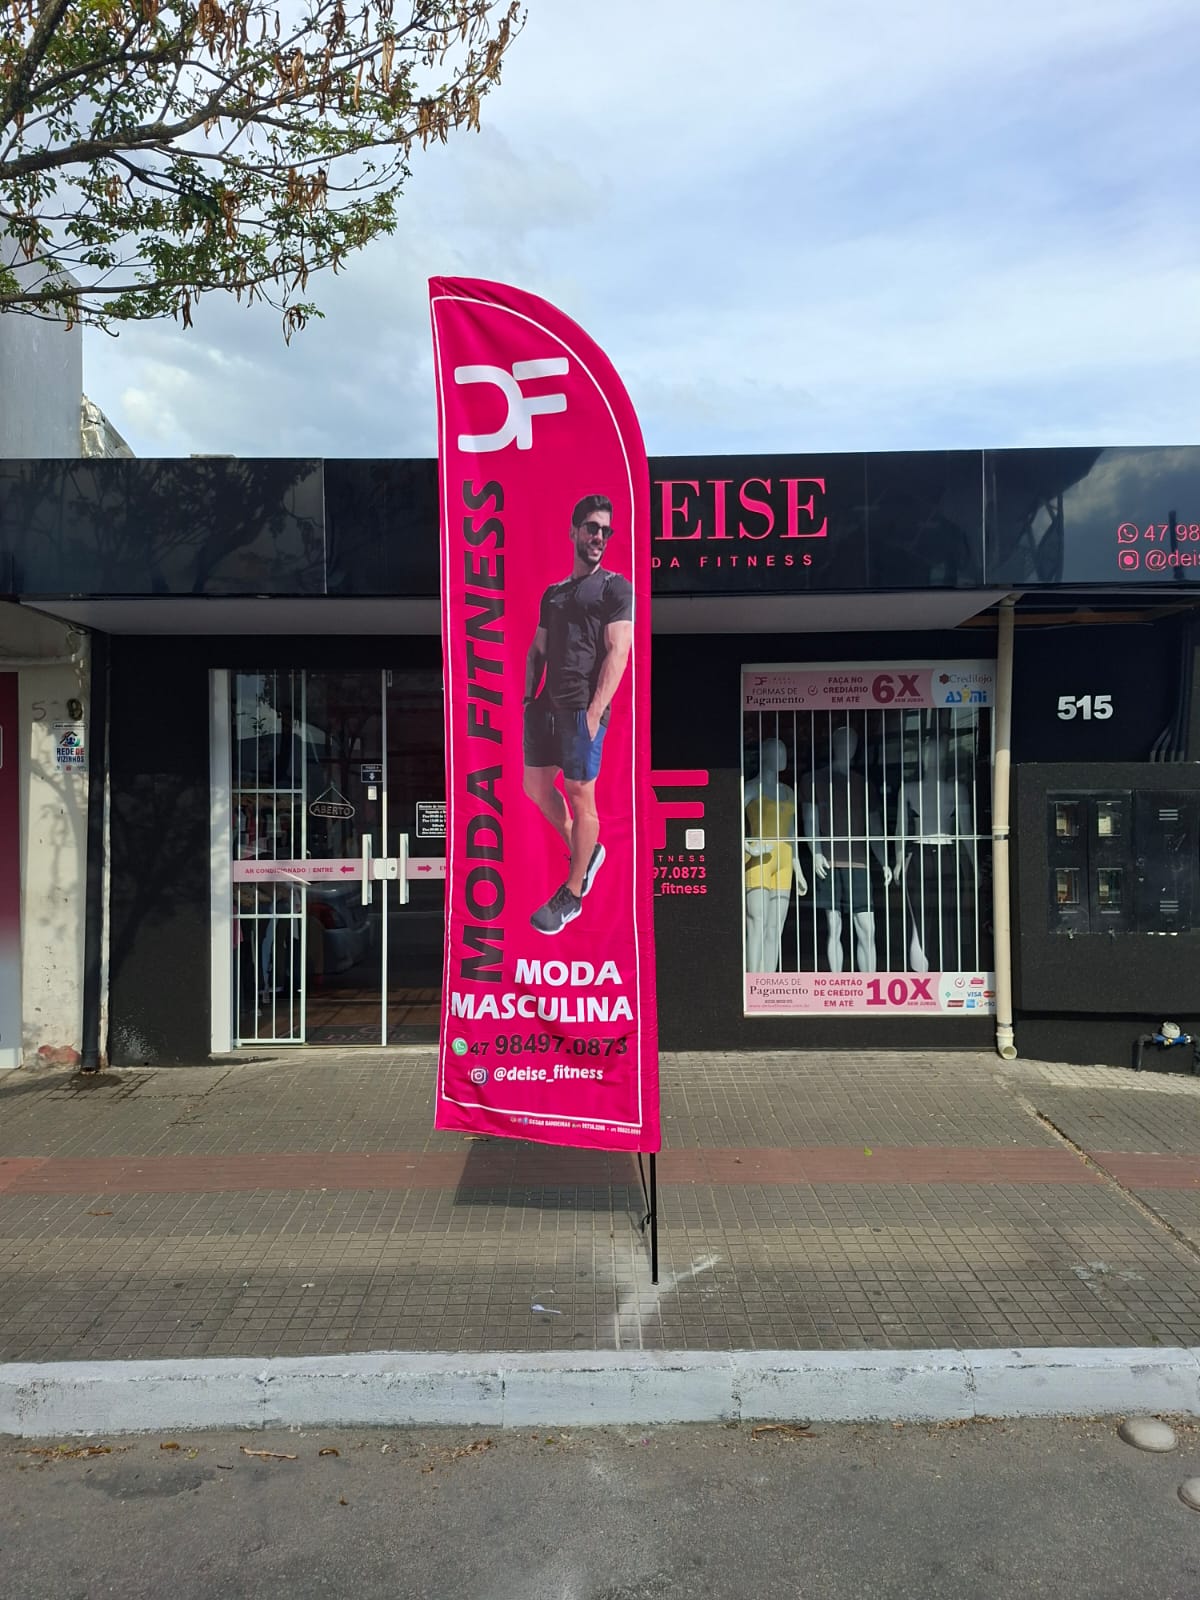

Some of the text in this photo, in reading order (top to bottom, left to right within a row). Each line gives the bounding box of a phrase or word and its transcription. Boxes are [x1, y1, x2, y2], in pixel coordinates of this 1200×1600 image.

[654, 478, 828, 540] EISE
[1144, 524, 1200, 543] 47 98
[700, 554, 813, 568] FITNESS
[828, 676, 864, 685] FAÇA NO
[752, 687, 799, 695] FORMAS DE
[823, 685, 869, 694] CREDIÁRIO
[871, 674, 921, 704] 6X
[746, 695, 805, 706] Pagamento
[1057, 695, 1114, 720] 515
[460, 480, 506, 983] MODA FITNESS
[57, 747, 85, 756] REDE DE
[56, 755, 85, 763] VIZINHOS
[313, 804, 351, 816] ABERTO
[514, 958, 623, 986] MODA
[829, 977, 863, 986] CARTÃO
[750, 986, 809, 997] Pagamento
[827, 987, 864, 997] CRÉDITO
[866, 978, 933, 1006] 10X
[451, 992, 634, 1023] MASCULINA
[824, 999, 836, 1007] EM
[470, 1033, 628, 1057] 47 98497.0873
[493, 1064, 604, 1082] @deise_fitness
